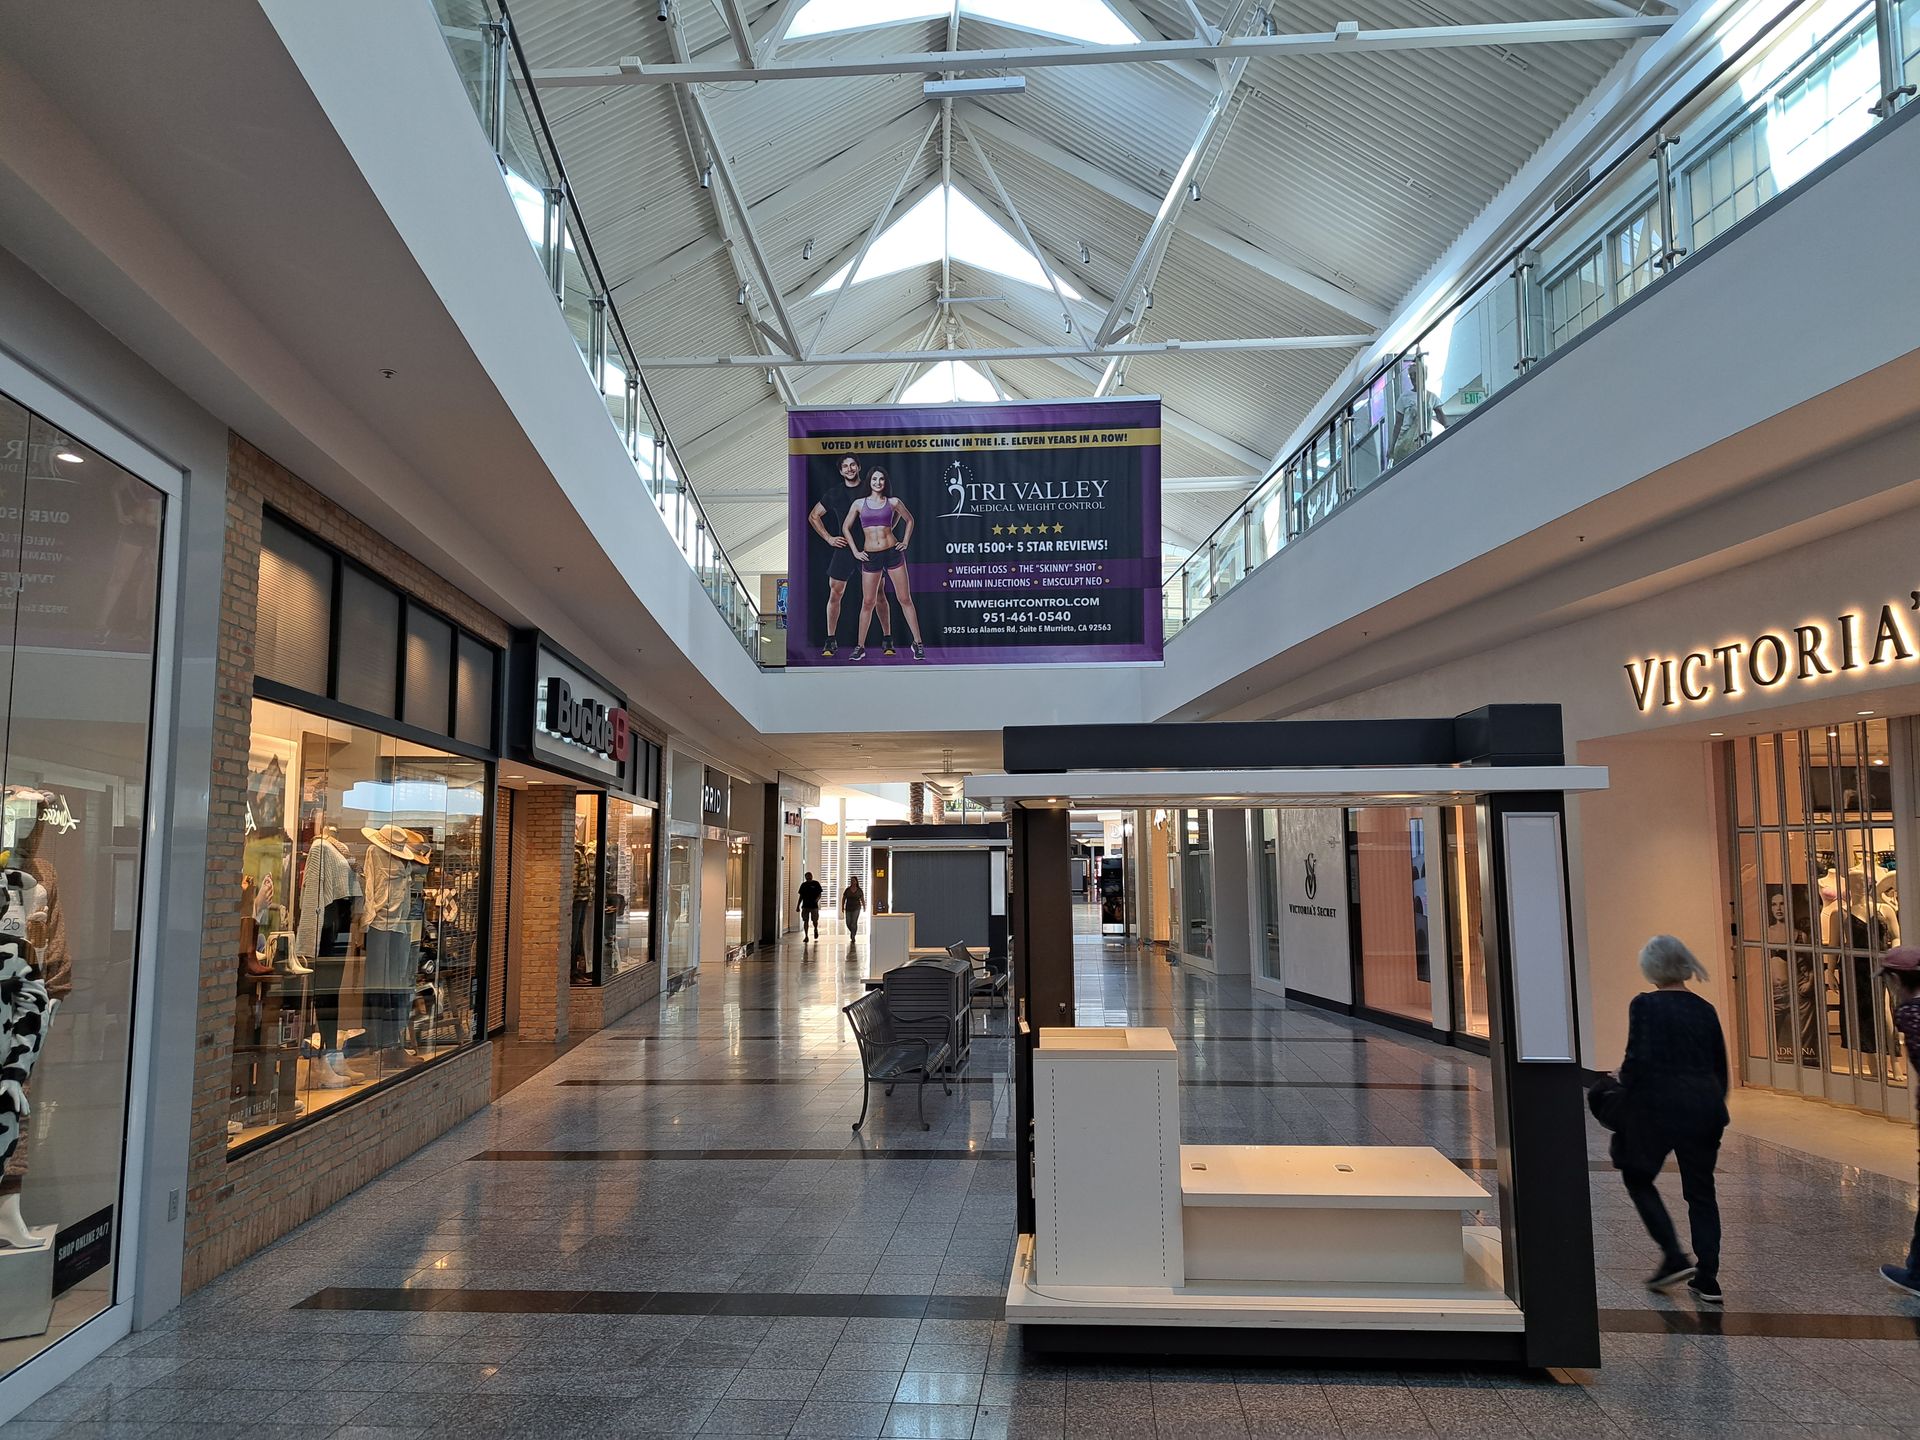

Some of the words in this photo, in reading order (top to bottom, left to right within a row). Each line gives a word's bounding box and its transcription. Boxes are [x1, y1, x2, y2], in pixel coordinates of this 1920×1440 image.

[1464, 392, 1479, 404] EXIT
[821, 441, 851, 450] VOTED
[854, 440, 864, 449] #1
[867, 439, 903, 449] WEIGHT
[905, 439, 927, 448] LOSS
[929, 438, 960, 447] CLINIC
[962, 438, 973, 446] IN
[974, 437, 992, 446] THE
[994, 437, 1009, 446] I.E.
[1011, 436, 1045, 445] ELEVEN
[1048, 435, 1077, 444] YEARS
[1079, 434, 1090, 443] IN
[1092, 434, 1098, 443] A
[1101, 433, 1127, 443] ROW!
[966, 482, 1006, 501] TRI
[1012, 479, 1109, 500] VALLEY
[970, 503, 1015, 513] MEDICAL
[1017, 502, 1056, 512] WEIGHT
[1058, 501, 1105, 511] CONTROL
[945, 542, 975, 554] OVER
[977, 541, 1014, 553] 1500+
[1017, 541, 1024, 552] 5
[1026, 540, 1053, 552] STAR
[1055, 539, 1108, 552] REVIEWS!
[955, 565, 986, 575] WEIGHT
[988, 565, 1008, 574] LOSS
[1018, 564, 1034, 573] THE
[1035, 563, 1073, 573] "SKINNY"
[1074, 562, 1097, 572] SHOT
[949, 579, 983, 589] VITAMIN
[984, 578, 1031, 588] INJECTIONS
[1042, 577, 1083, 587] EMSCULPT
[1085, 576, 1103, 586] NEO
[954, 597, 1100, 609] TVMWEIGHTCONTROL.COM
[982, 611, 1071, 623] 951-461-0540
[943, 626, 966, 634] 39525
[967, 626, 978, 634] Los
[979, 625, 1005, 634] Alamos
[1006, 625, 1018, 634] Rd,
[1019, 625, 1037, 633] Suite
[1044, 624, 1077, 633] Murrieta,
[1078, 624, 1087, 632] CA
[1088, 623, 1112, 632] 92563
[547, 677, 614, 754] Buckle
[1289, 903, 1316, 916] VICTORIA'S
[1316, 905, 1336, 918] SECRET
[58, 1241, 74, 1261] SHOP
[75, 1229, 95, 1251] ONLINE
[95, 1221, 109, 1241] 24/7
